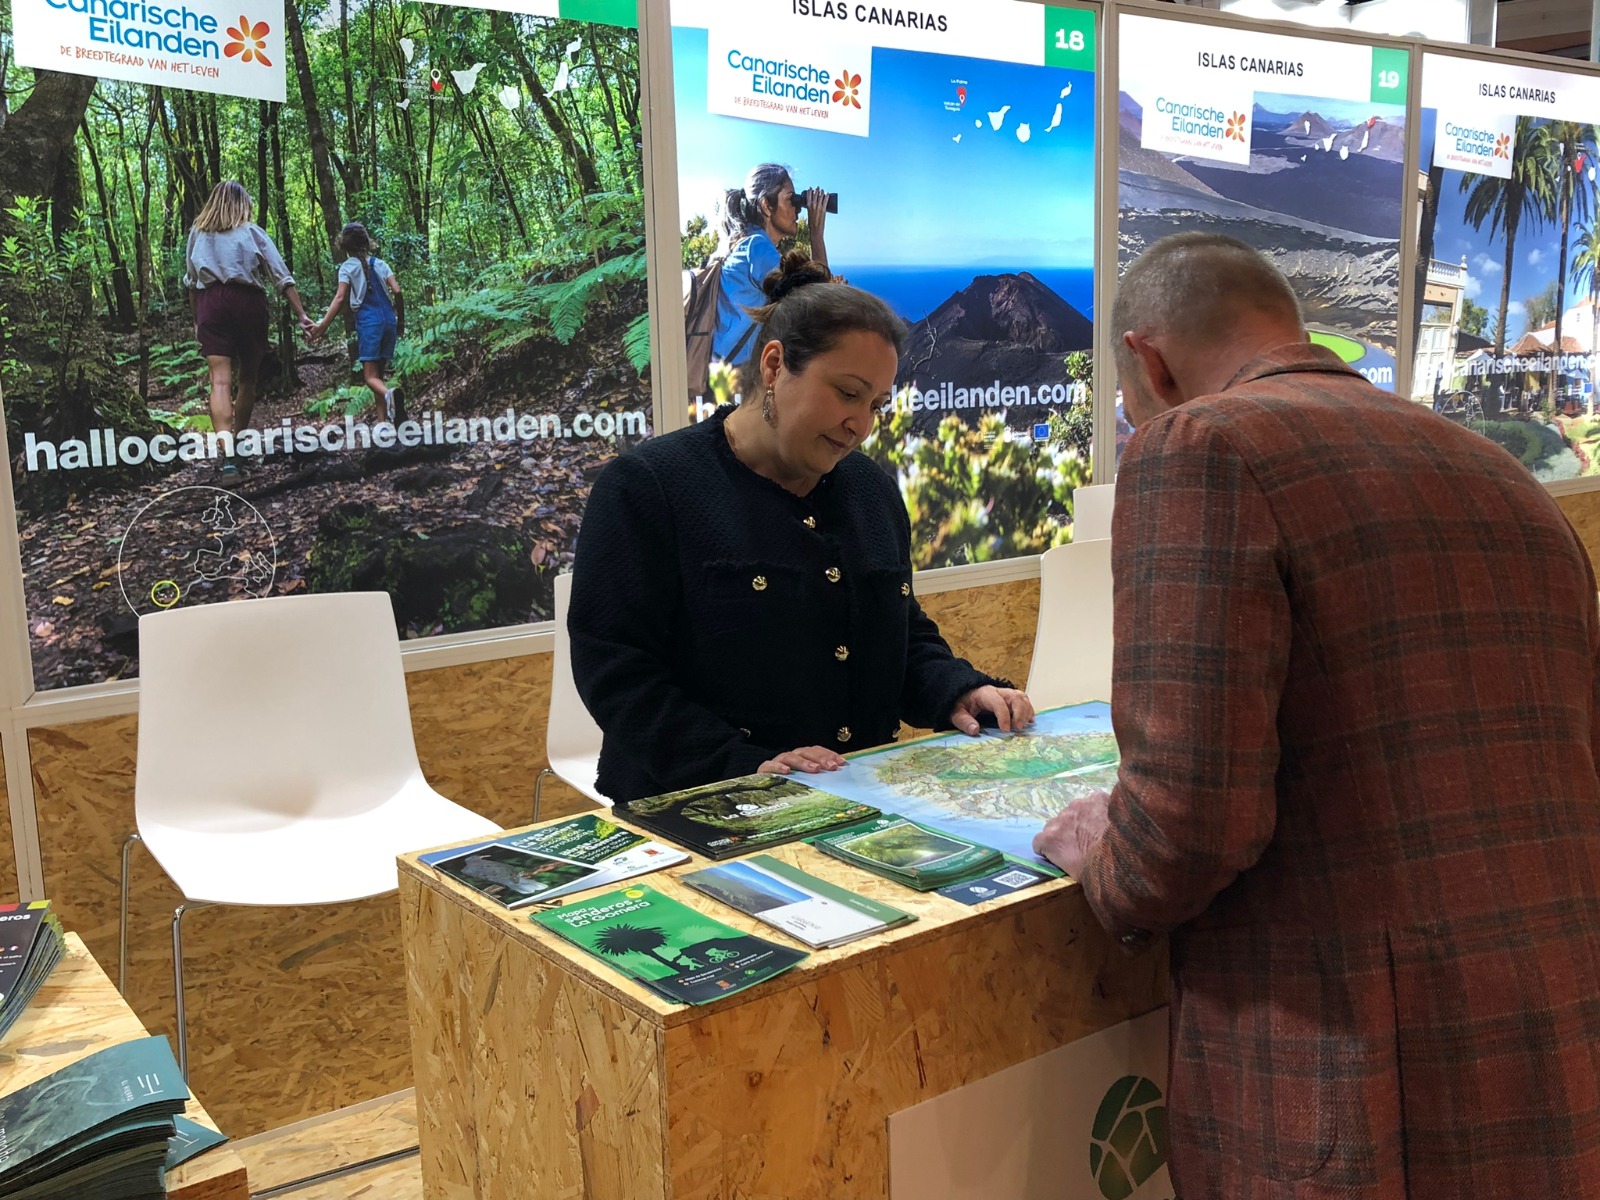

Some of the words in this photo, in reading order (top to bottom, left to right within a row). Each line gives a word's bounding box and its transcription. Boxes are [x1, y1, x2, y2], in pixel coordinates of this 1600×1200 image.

[792, 0, 848, 20] ISLAS
[855, 4, 948, 32] CANARIAS
[89, 16, 220, 60] Eilanden
[1055, 28, 1085, 51] 18
[60, 45, 72, 56] DE
[75, 46, 144, 67] BREEDTEGRAAD
[147, 58, 167, 71] VAN
[171, 62, 190, 74] HET
[190, 64, 220, 78] LEVEN
[727, 49, 830, 85] Canarische
[1198, 51, 1236, 71] ISLAS
[1241, 56, 1304, 78] CANARIAS
[751, 75, 831, 105] Eilanden
[1377, 69, 1400, 89] 19
[1479, 83, 1507, 98] ISLAS
[1509, 86, 1556, 104] CANARIAS
[1156, 97, 1225, 123] Canarische
[1171, 116, 1224, 140] Eilanden
[1445, 122, 1495, 144] Canarische
[1456, 138, 1494, 157] Eilanden
[25, 405, 648, 472] hallocanarischeeilanden.com
[557, 907, 587, 920] Mapa
[564, 899, 633, 923] senderos
[570, 919, 591, 928] La
[591, 901, 651, 921] Gomera
